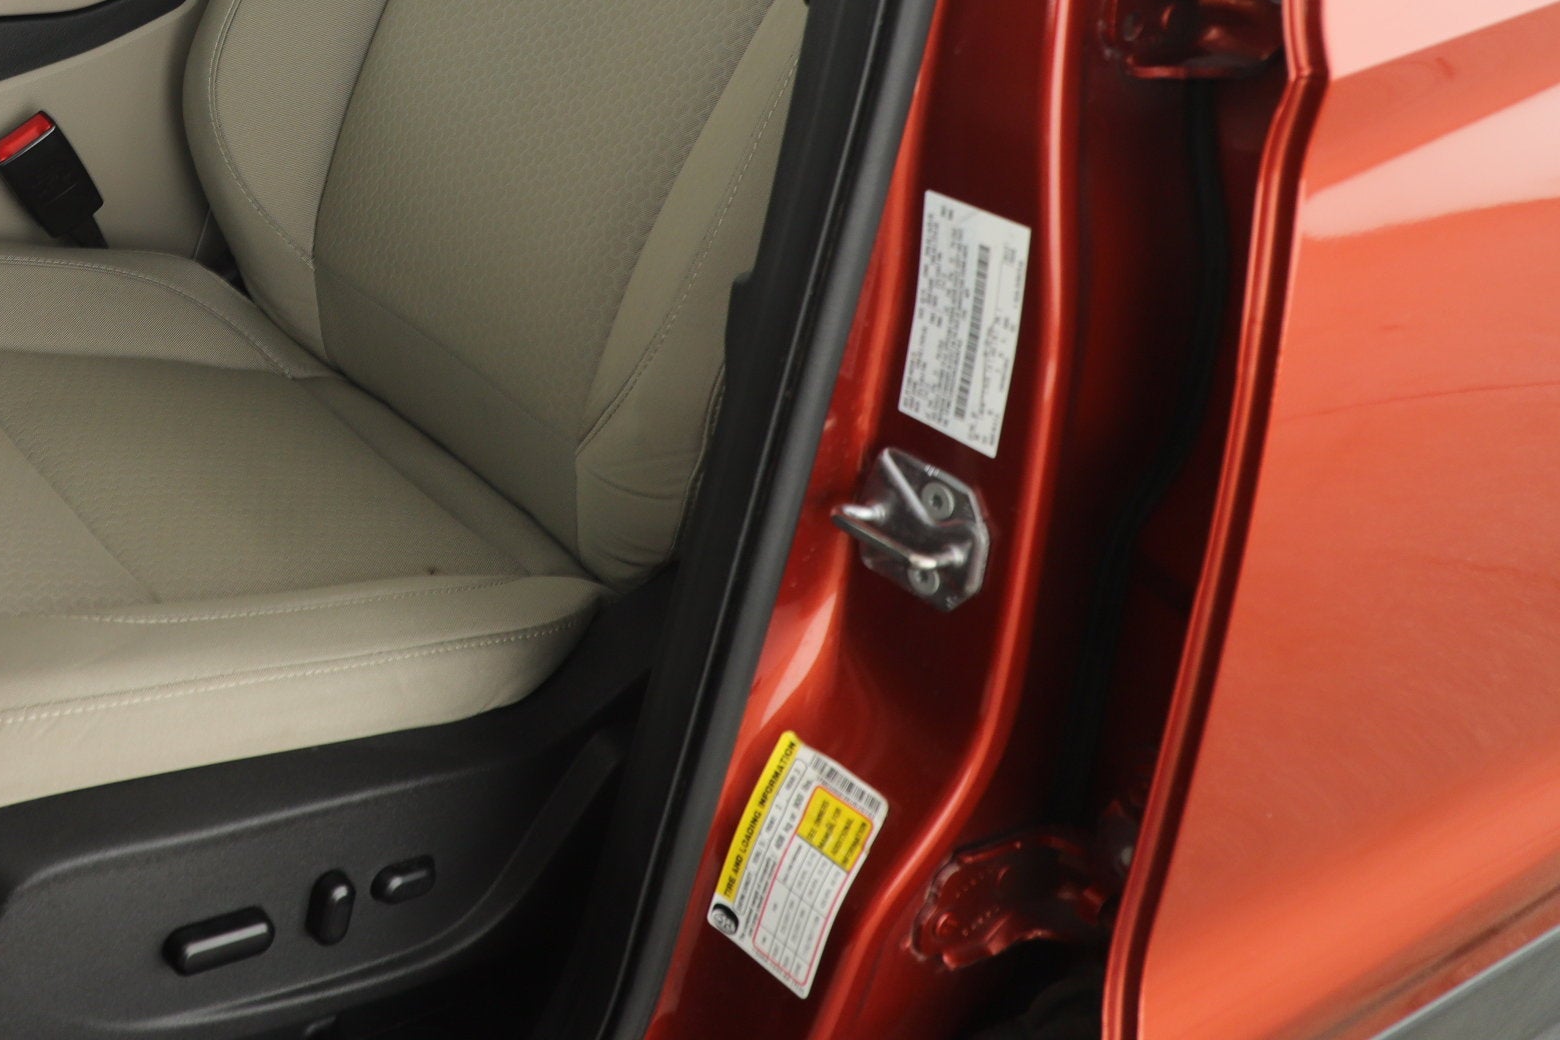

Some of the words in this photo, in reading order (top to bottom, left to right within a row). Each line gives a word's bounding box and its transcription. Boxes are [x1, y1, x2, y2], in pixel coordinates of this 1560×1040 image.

[723, 876, 736, 898] TIRE
[732, 855, 743, 875] AND
[741, 811, 762, 853] LOADING
[759, 741, 796, 807] INFORMATION
